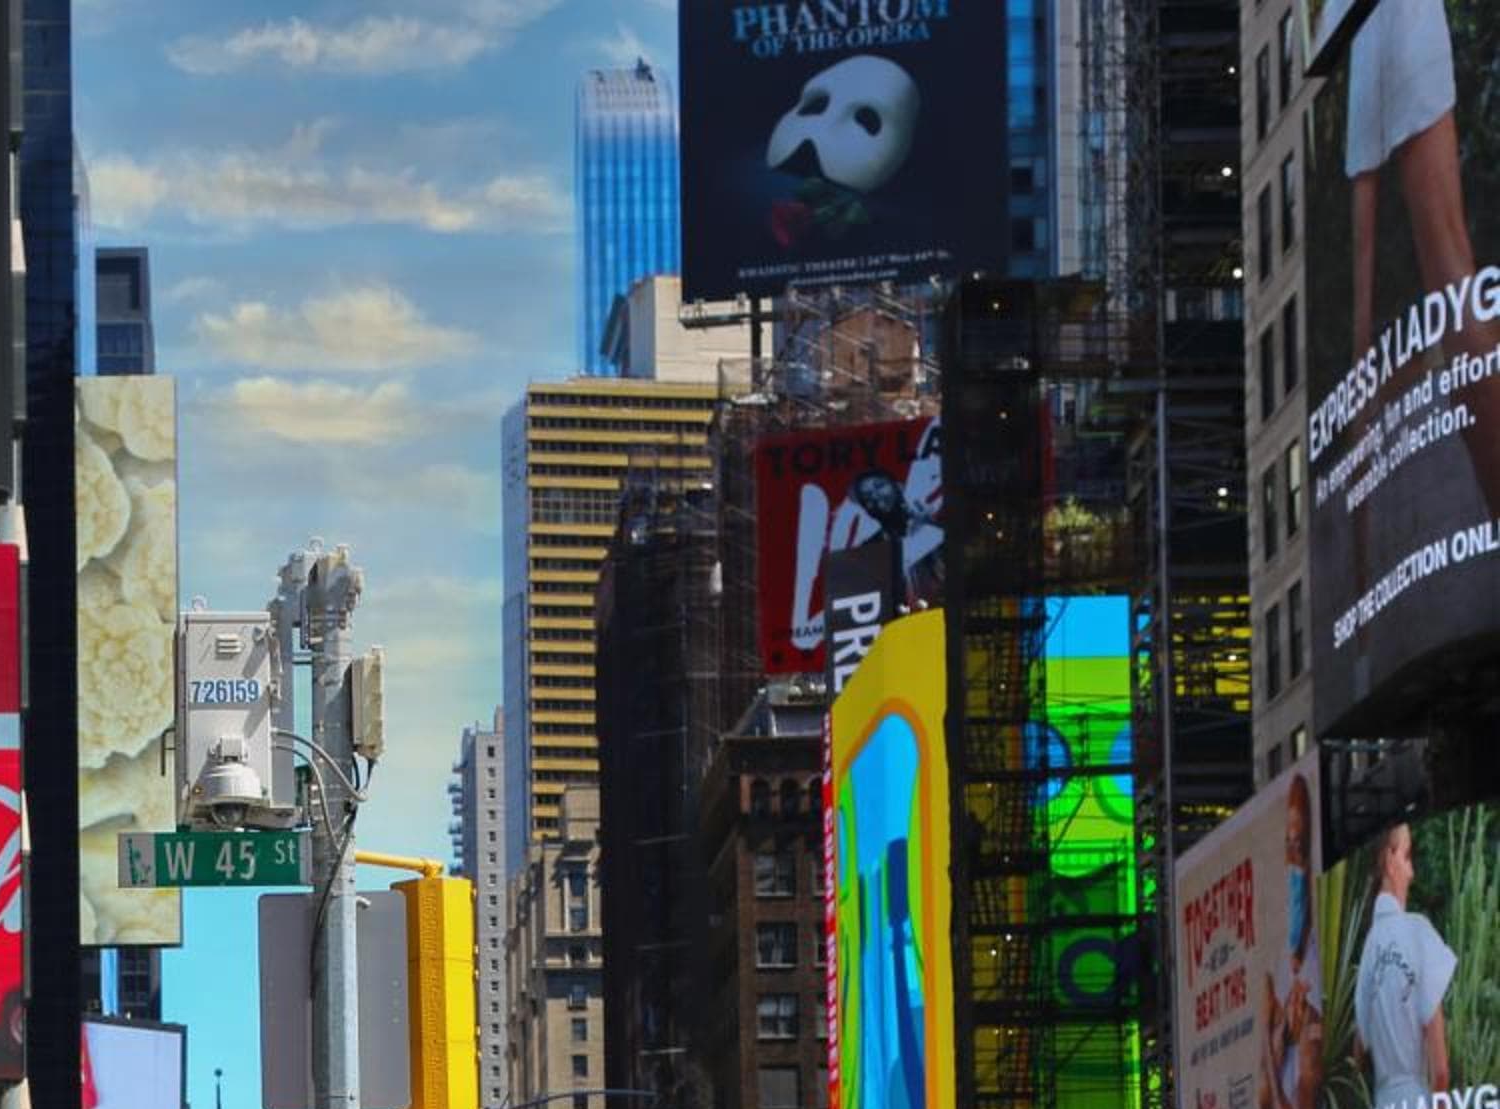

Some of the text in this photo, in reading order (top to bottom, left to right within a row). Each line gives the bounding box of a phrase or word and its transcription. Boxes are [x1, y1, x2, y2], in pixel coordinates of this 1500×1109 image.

[752, 20, 932, 58] OF THE OPERA
[1309, 346, 1378, 463] EXPRESS
[1380, 327, 1393, 385] X
[1404, 369, 1433, 417] and
[1389, 403, 1476, 470] collection.
[1375, 538, 1449, 612] COLLECTION
[190, 679, 260, 703] 726159
[163, 838, 297, 882] W 45 St
